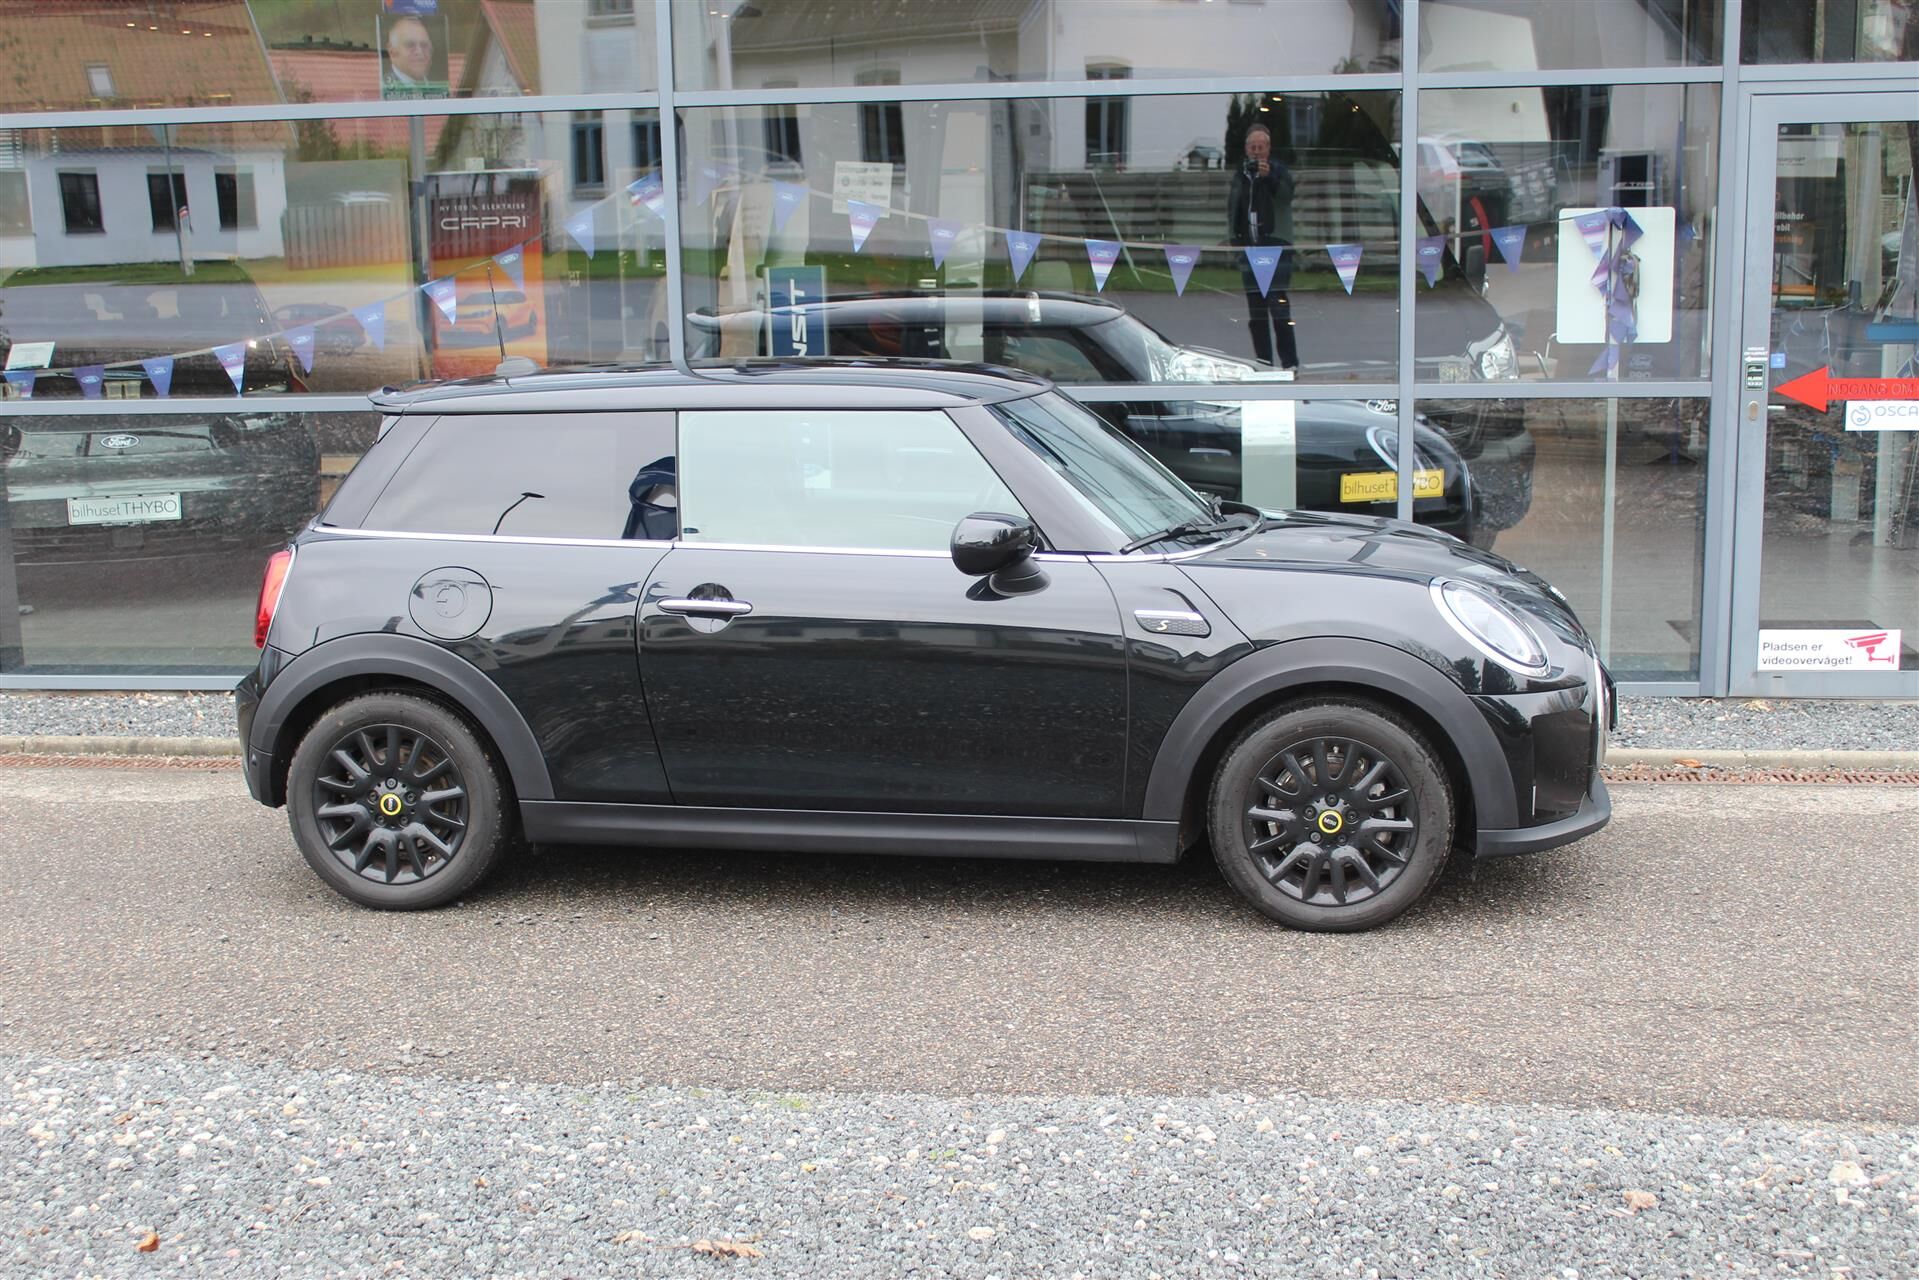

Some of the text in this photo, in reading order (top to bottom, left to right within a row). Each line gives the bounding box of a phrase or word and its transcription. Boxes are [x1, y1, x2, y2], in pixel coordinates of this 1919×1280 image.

[441, 216, 526, 230] CAPRI
[1826, 382, 1915, 395] INDGANG OM
[1156, 619, 1169, 631] S
[1762, 642, 1823, 652] Pladsen er
[1762, 656, 1853, 667] videoovervåget!
